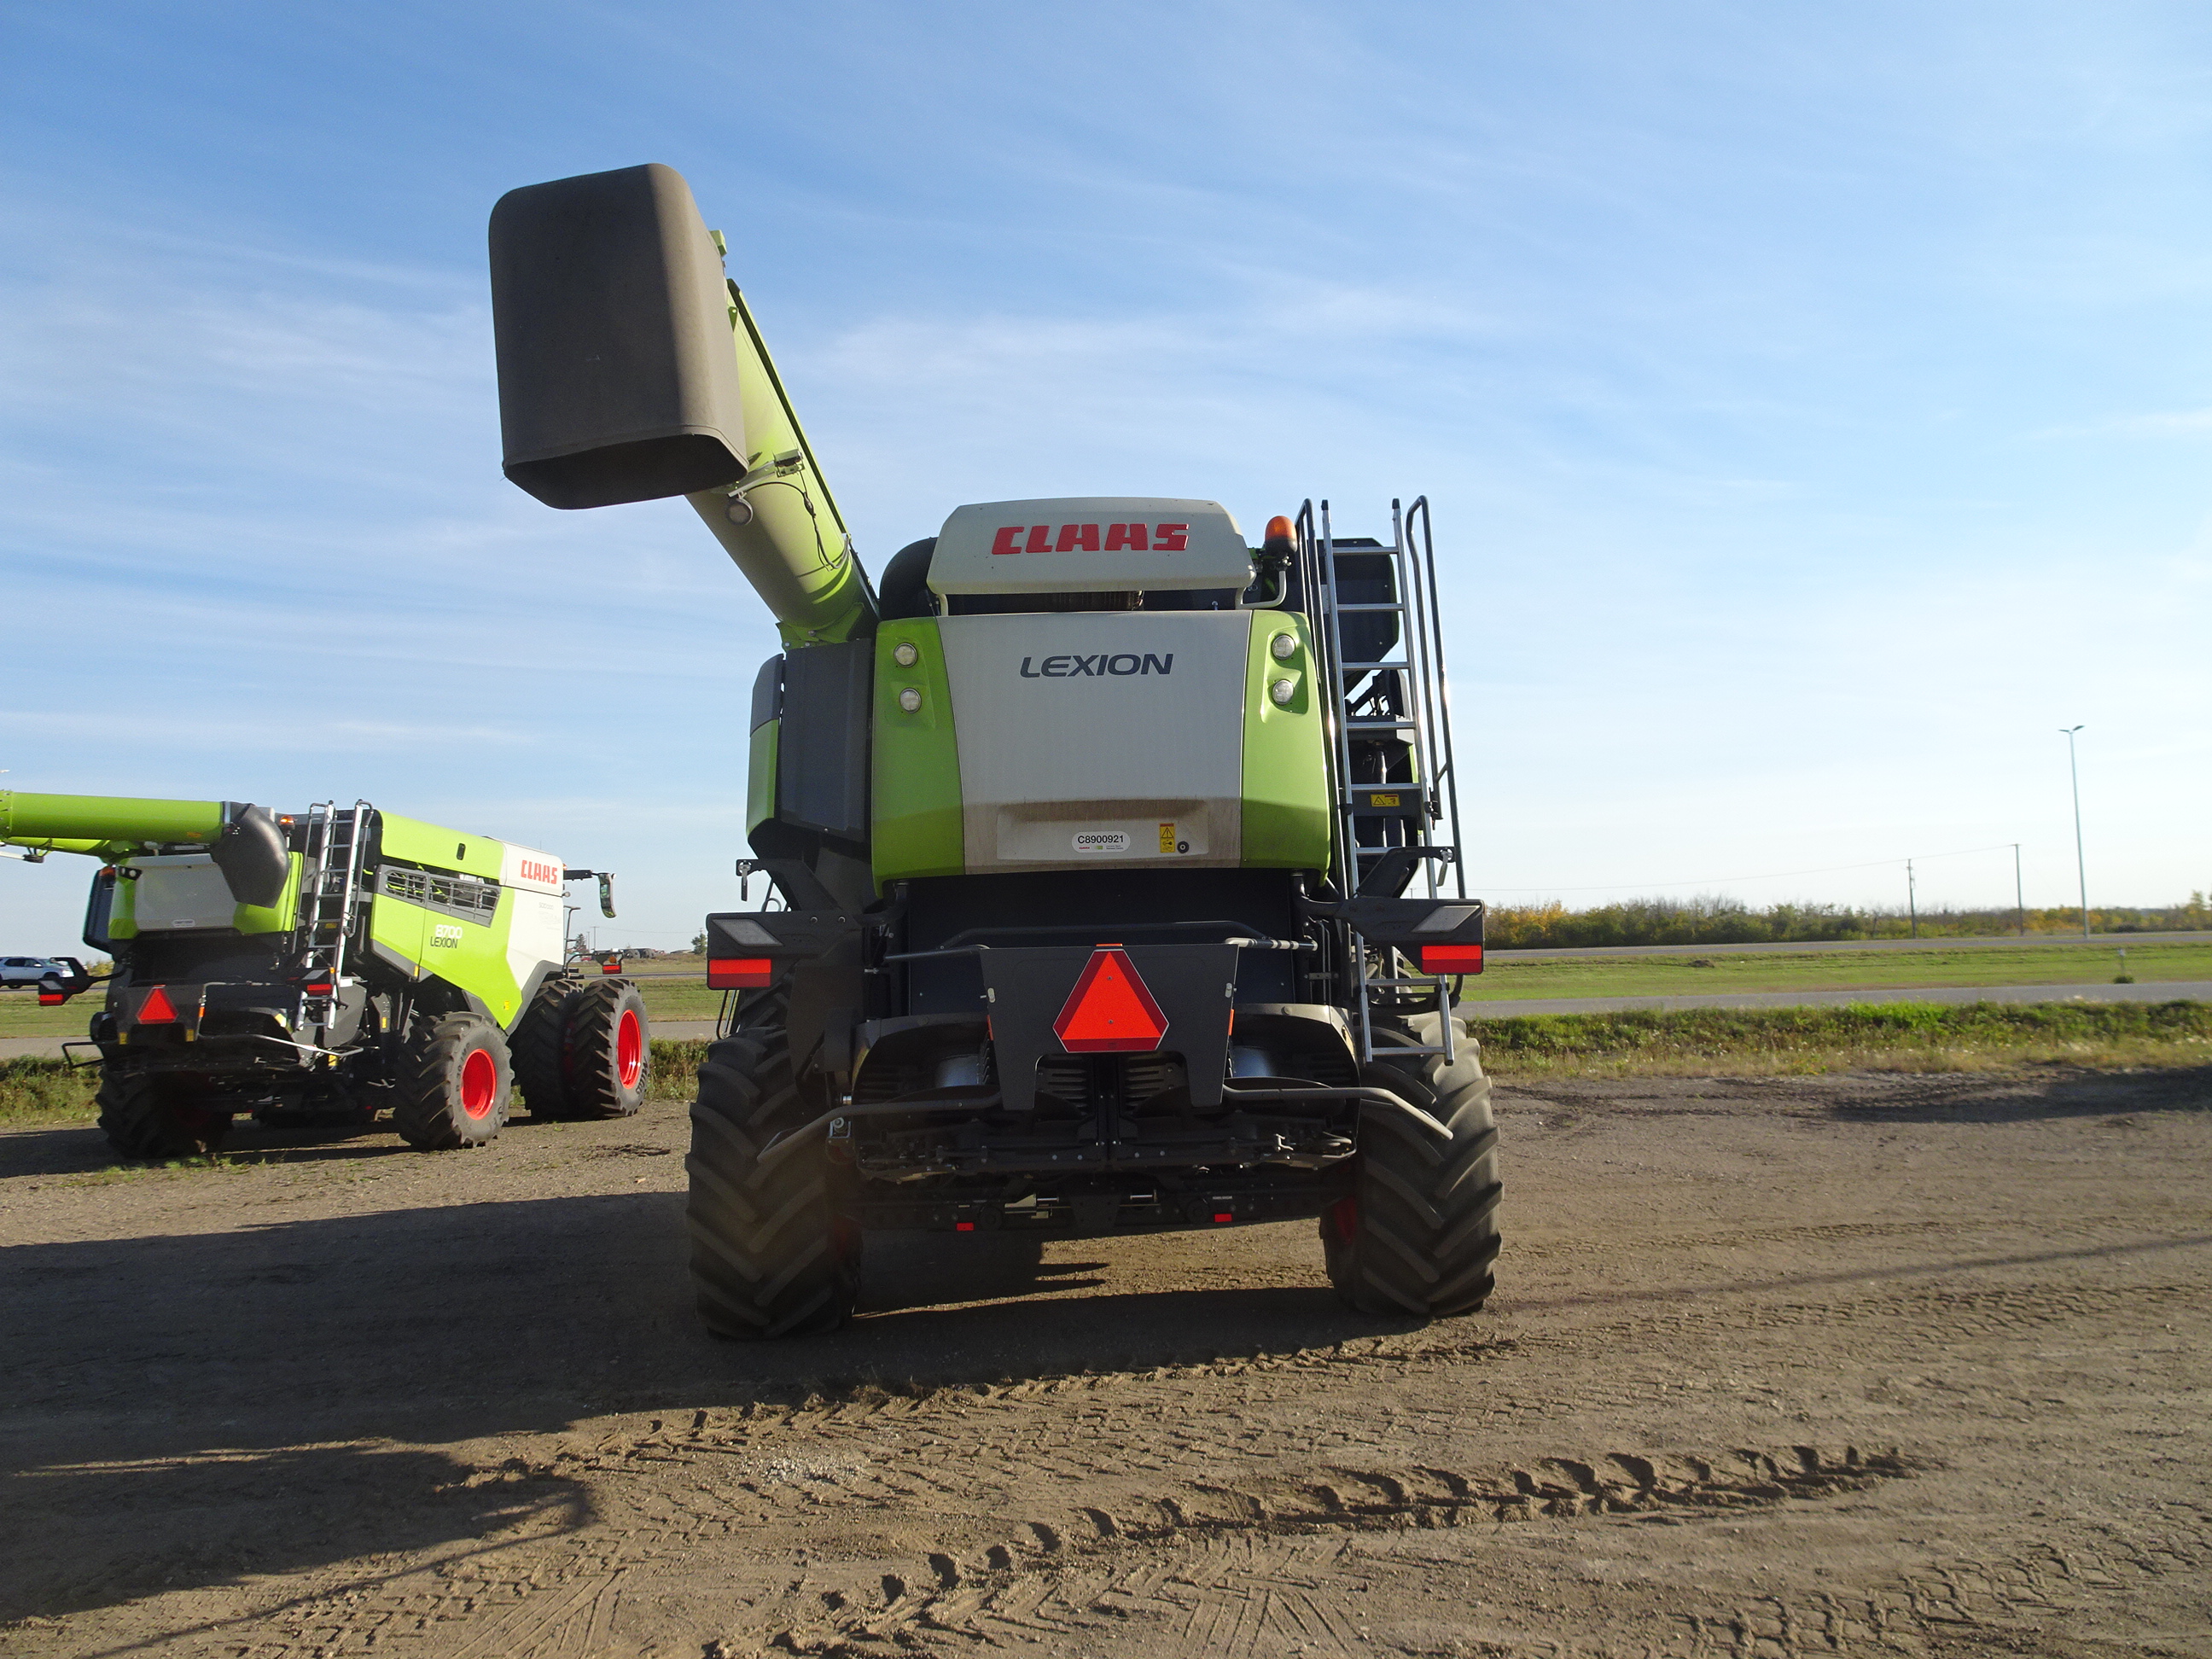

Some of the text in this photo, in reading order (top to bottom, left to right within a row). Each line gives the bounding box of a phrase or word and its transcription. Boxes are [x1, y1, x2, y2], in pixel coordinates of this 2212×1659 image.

[991, 523, 1190, 555] CLAAS
[1020, 653, 1174, 678] LEXION
[1077, 835, 1124, 844] C8900921
[521, 859, 558, 885] CLAAS
[435, 924, 463, 939] 8700
[430, 936, 458, 949] LEXION
